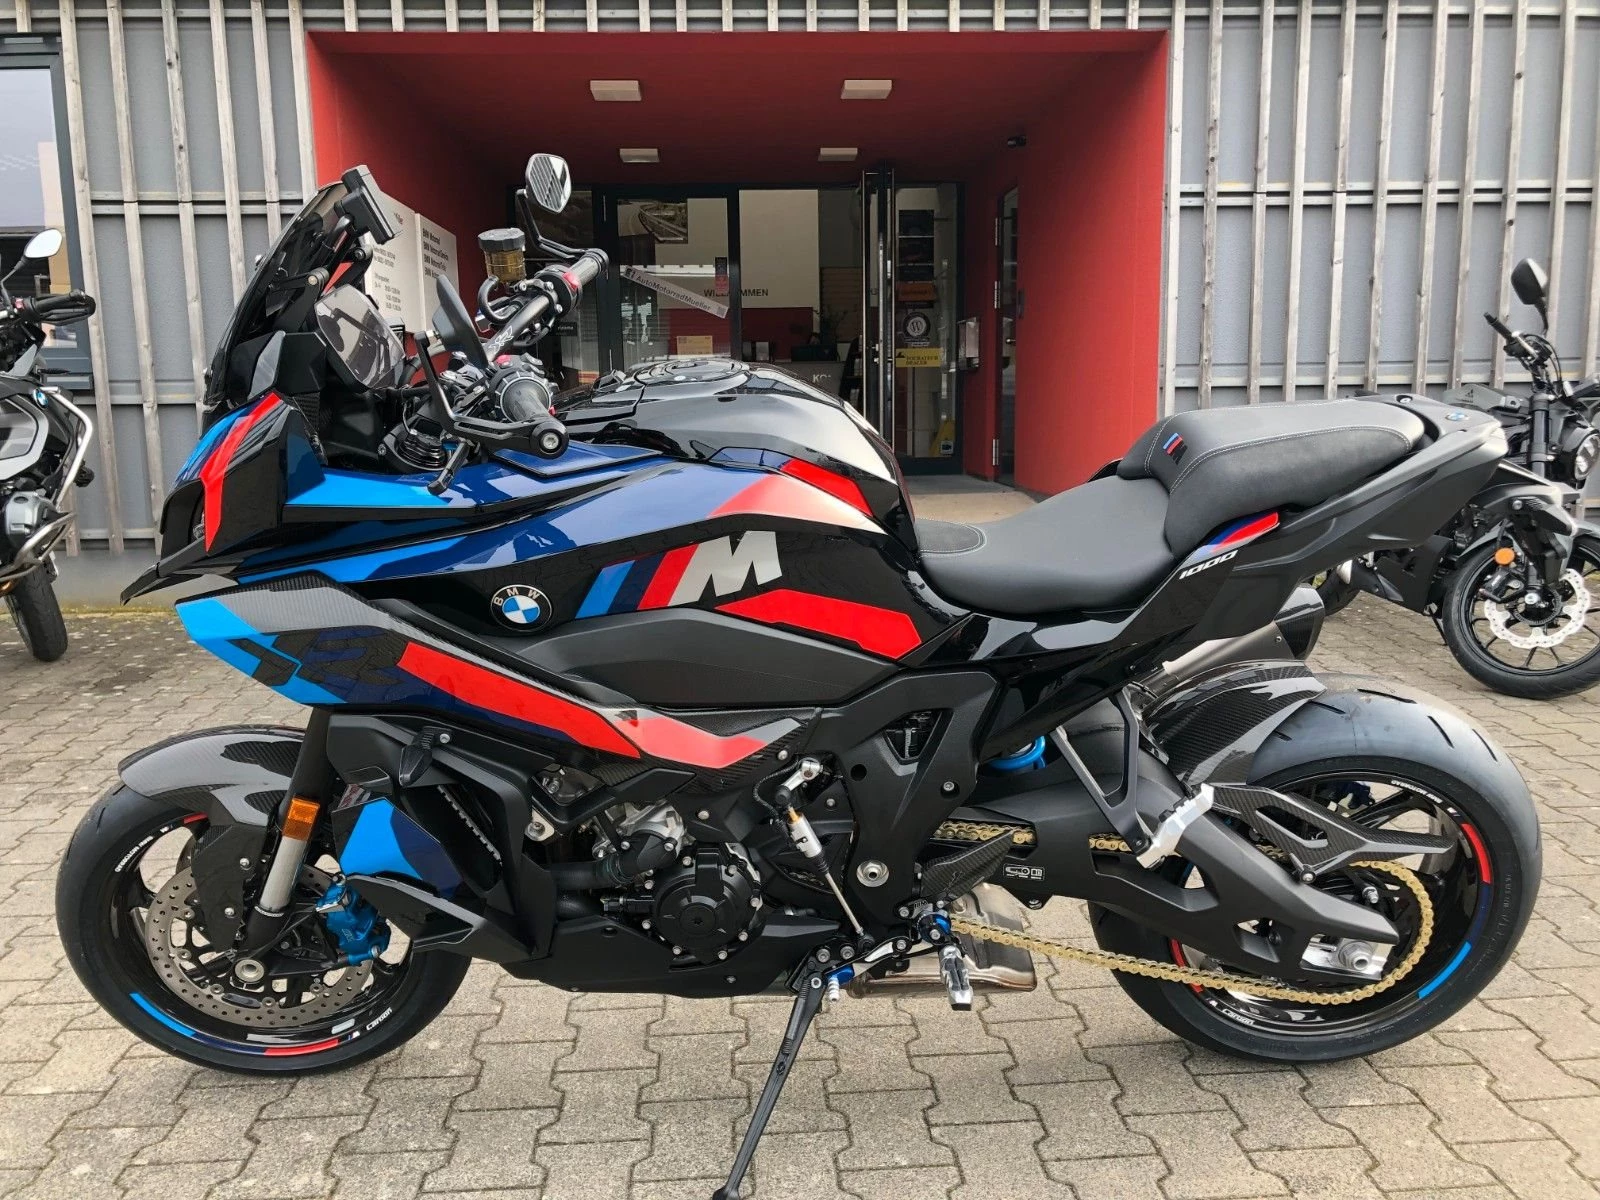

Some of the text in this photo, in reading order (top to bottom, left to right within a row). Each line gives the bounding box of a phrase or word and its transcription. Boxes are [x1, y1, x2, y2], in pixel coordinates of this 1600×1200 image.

[667, 530, 783, 607] M
[1178, 549, 1238, 580] 1000
[493, 586, 541, 608] BMW
[365, 1006, 393, 1030] Carbon
